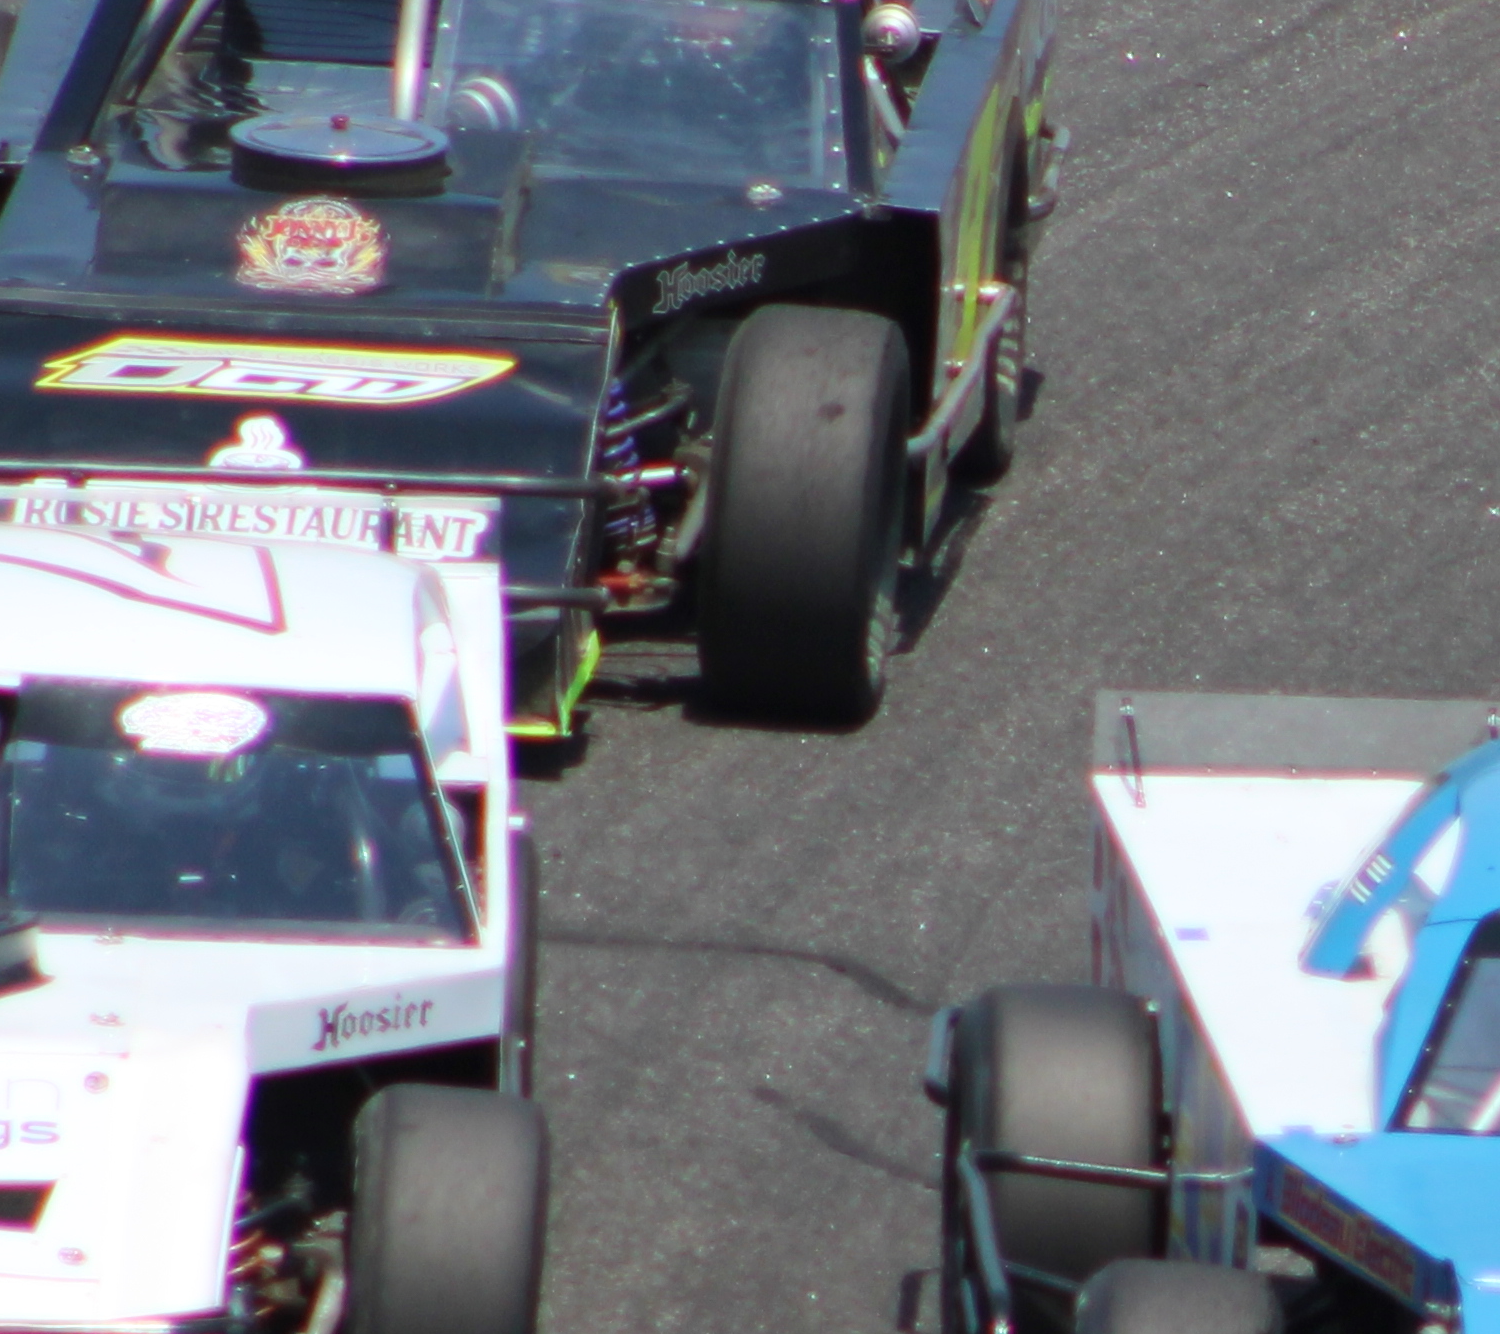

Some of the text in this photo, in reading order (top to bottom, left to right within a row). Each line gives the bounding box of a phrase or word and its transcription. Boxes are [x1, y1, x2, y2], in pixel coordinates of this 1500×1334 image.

[652, 249, 766, 314] Hoosier
[391, 360, 482, 376] WORKS
[312, 991, 433, 1051] Hoosier
